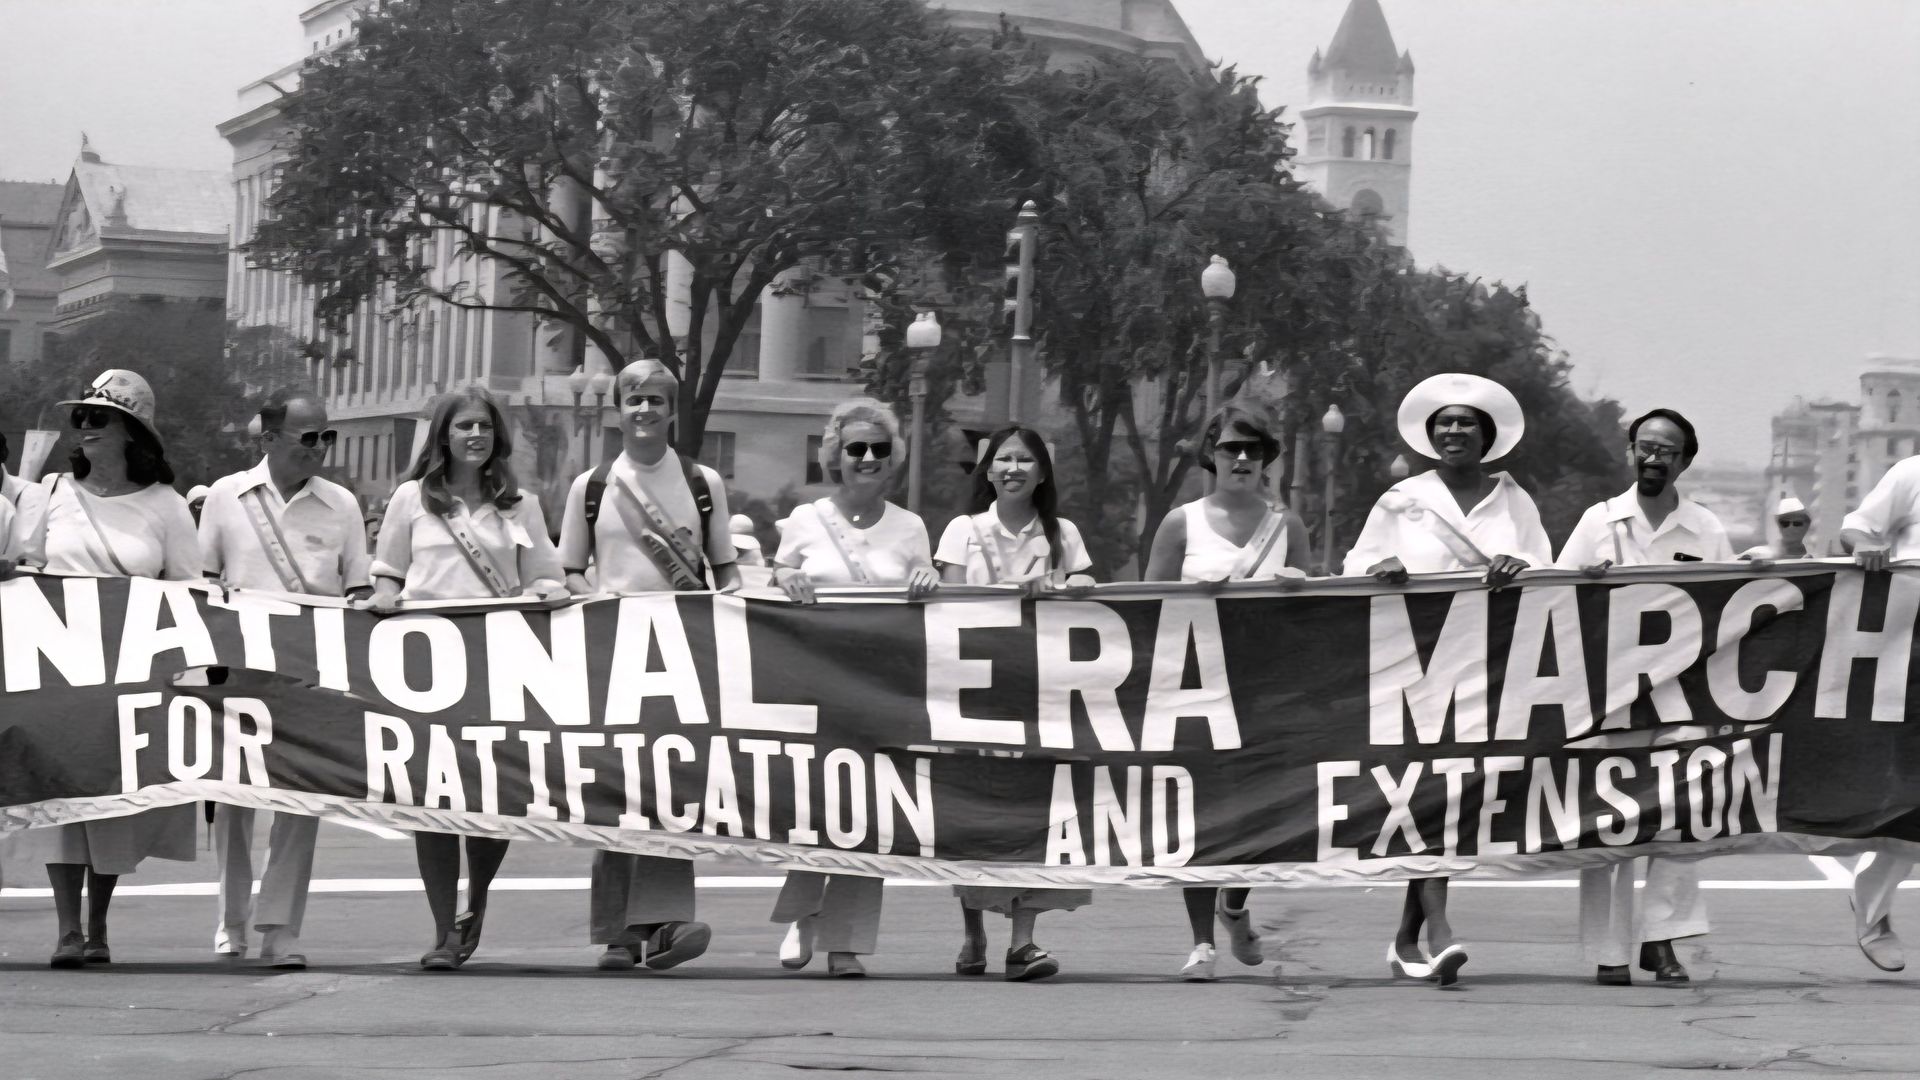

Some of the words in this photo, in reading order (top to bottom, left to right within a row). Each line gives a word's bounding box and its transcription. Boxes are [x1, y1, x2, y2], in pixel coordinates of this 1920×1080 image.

[0, 576, 818, 735] NATIONAL
[924, 598, 1242, 752] ERA
[1369, 573, 1919, 745] MARCH
[118, 692, 273, 792] FOR
[364, 712, 936, 857] RATIFICATION
[1044, 764, 1196, 868] AND
[1315, 732, 1784, 863] EXTENSION
